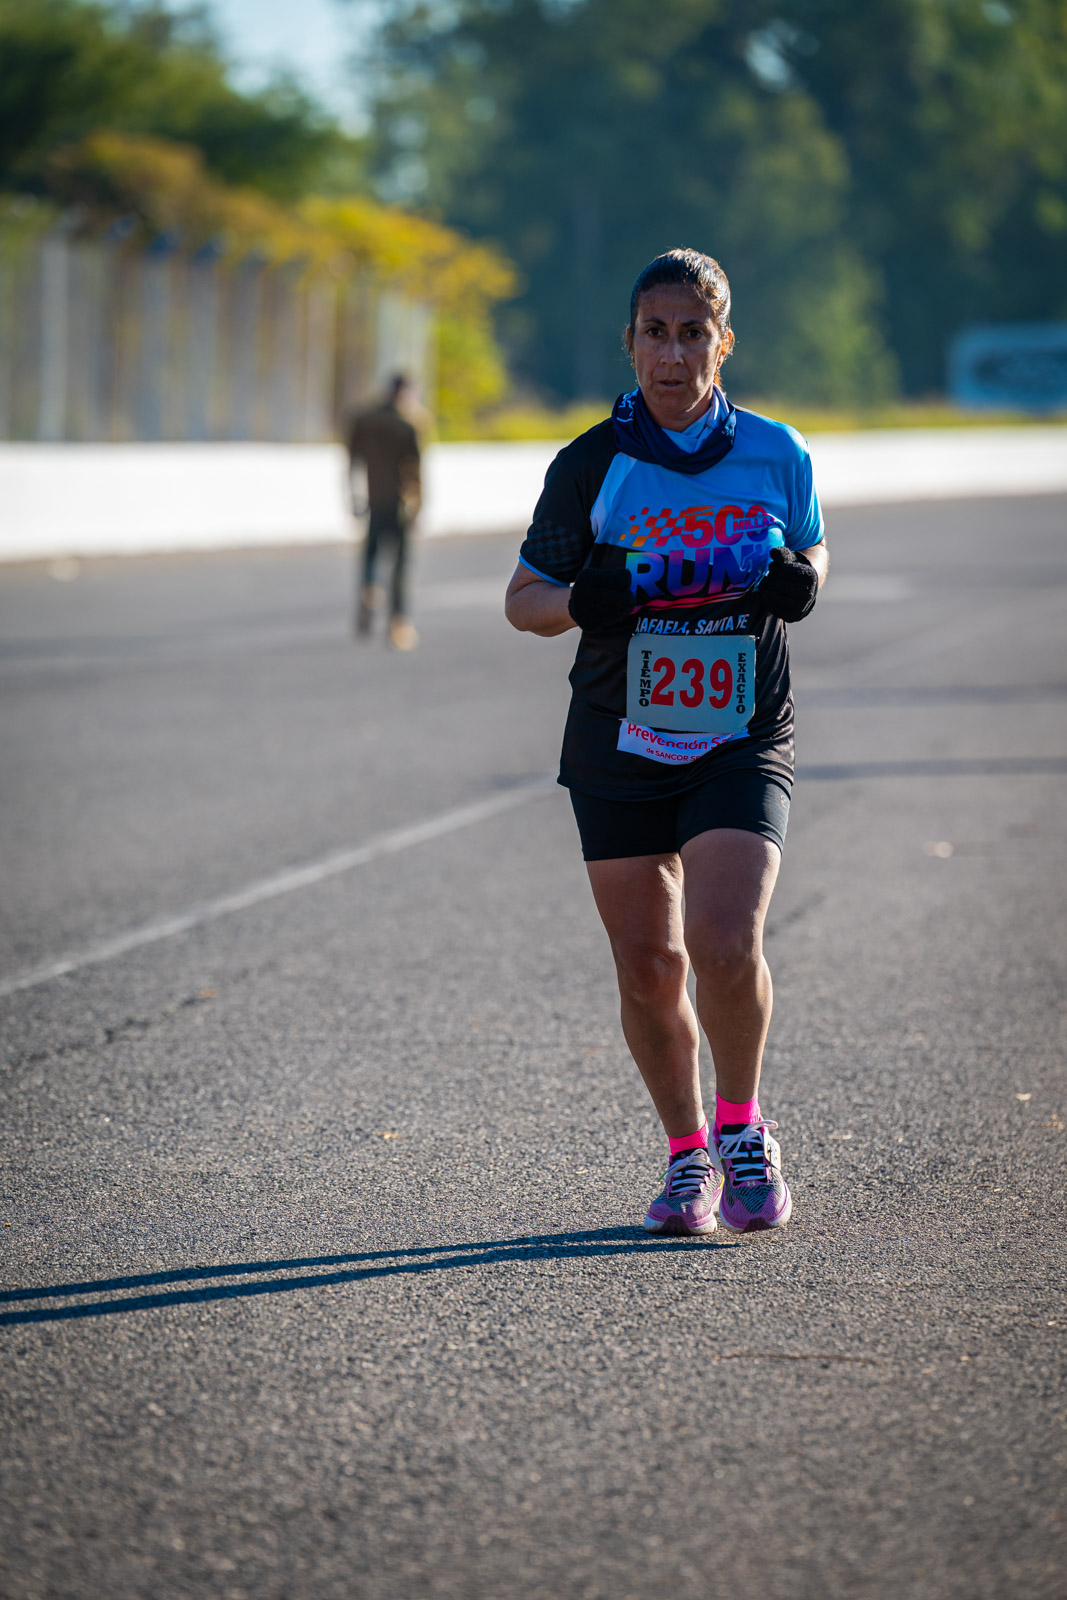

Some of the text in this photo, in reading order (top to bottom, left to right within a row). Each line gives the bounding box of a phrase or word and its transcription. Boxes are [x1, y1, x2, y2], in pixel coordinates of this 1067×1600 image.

[733, 516, 776, 532] MILLAS
[625, 545, 757, 600] RUN
[694, 615, 734, 635] SANTA
[639, 650, 652, 707] TIEMPO
[650, 657, 733, 710] 239
[736, 653, 747, 714] EXACTO
[627, 722, 708, 750] Prevención
[646, 747, 654, 755] de
[655, 750, 689, 762] SANCOR
